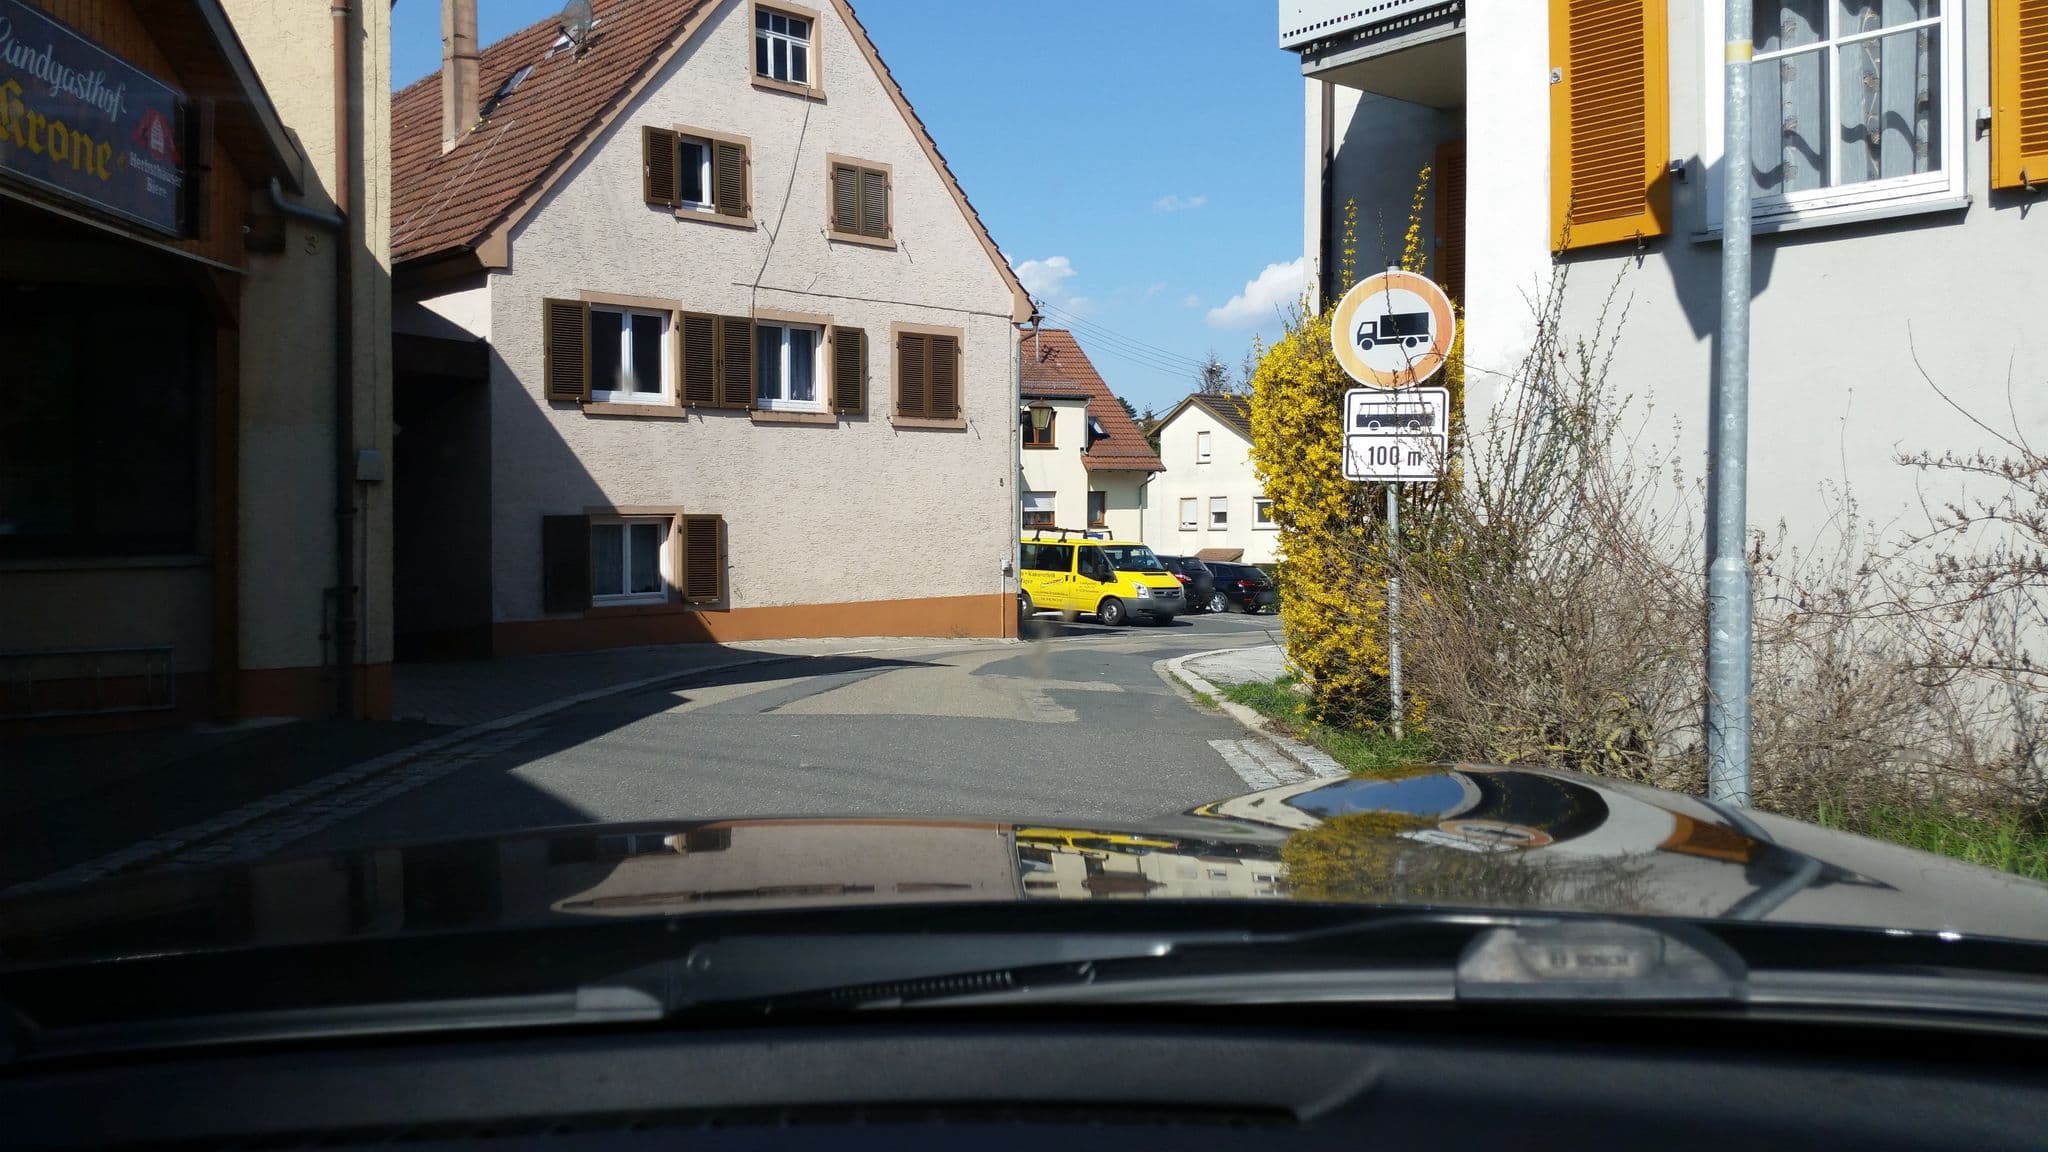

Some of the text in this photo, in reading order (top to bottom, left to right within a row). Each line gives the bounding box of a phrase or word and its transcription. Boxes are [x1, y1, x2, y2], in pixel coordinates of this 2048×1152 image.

[0, 79, 112, 181] Krone
[1368, 445, 1421, 467] 100 m
